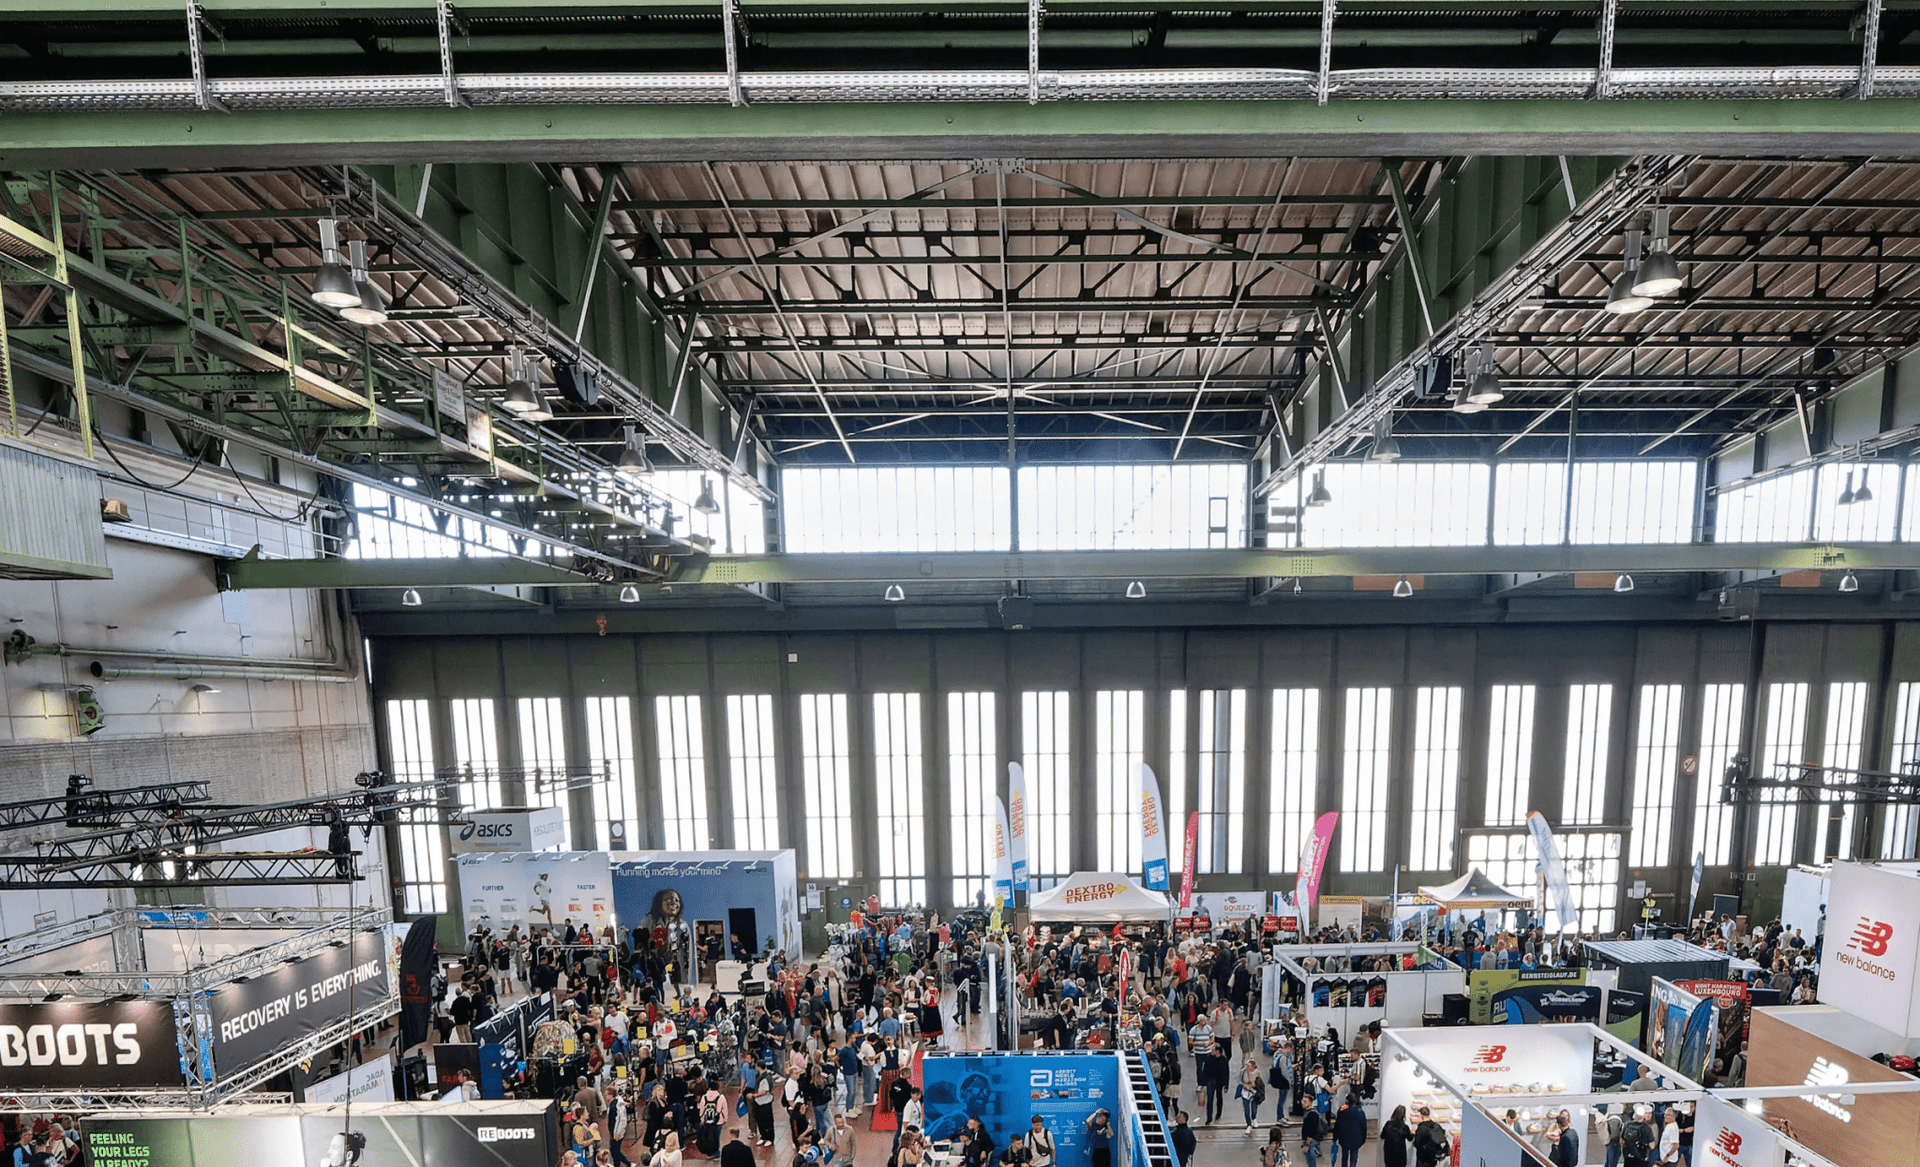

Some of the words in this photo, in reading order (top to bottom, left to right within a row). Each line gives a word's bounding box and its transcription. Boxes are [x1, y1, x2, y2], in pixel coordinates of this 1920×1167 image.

[1066, 882, 1114, 897] DEXTRO
[1066, 889, 1115, 904] ENERGY
[1836, 951, 1855, 966] new
[1856, 955, 1896, 982] balance
[221, 994, 291, 1043] RECOVERY
[295, 989, 308, 1010] IS
[0, 1023, 141, 1066] BOOTS
[90, 1133, 135, 1145] FEELING
[91, 1146, 121, 1158] YOUR
[123, 1146, 150, 1158] LEGS
[94, 1159, 149, 1167] ALREADY?
